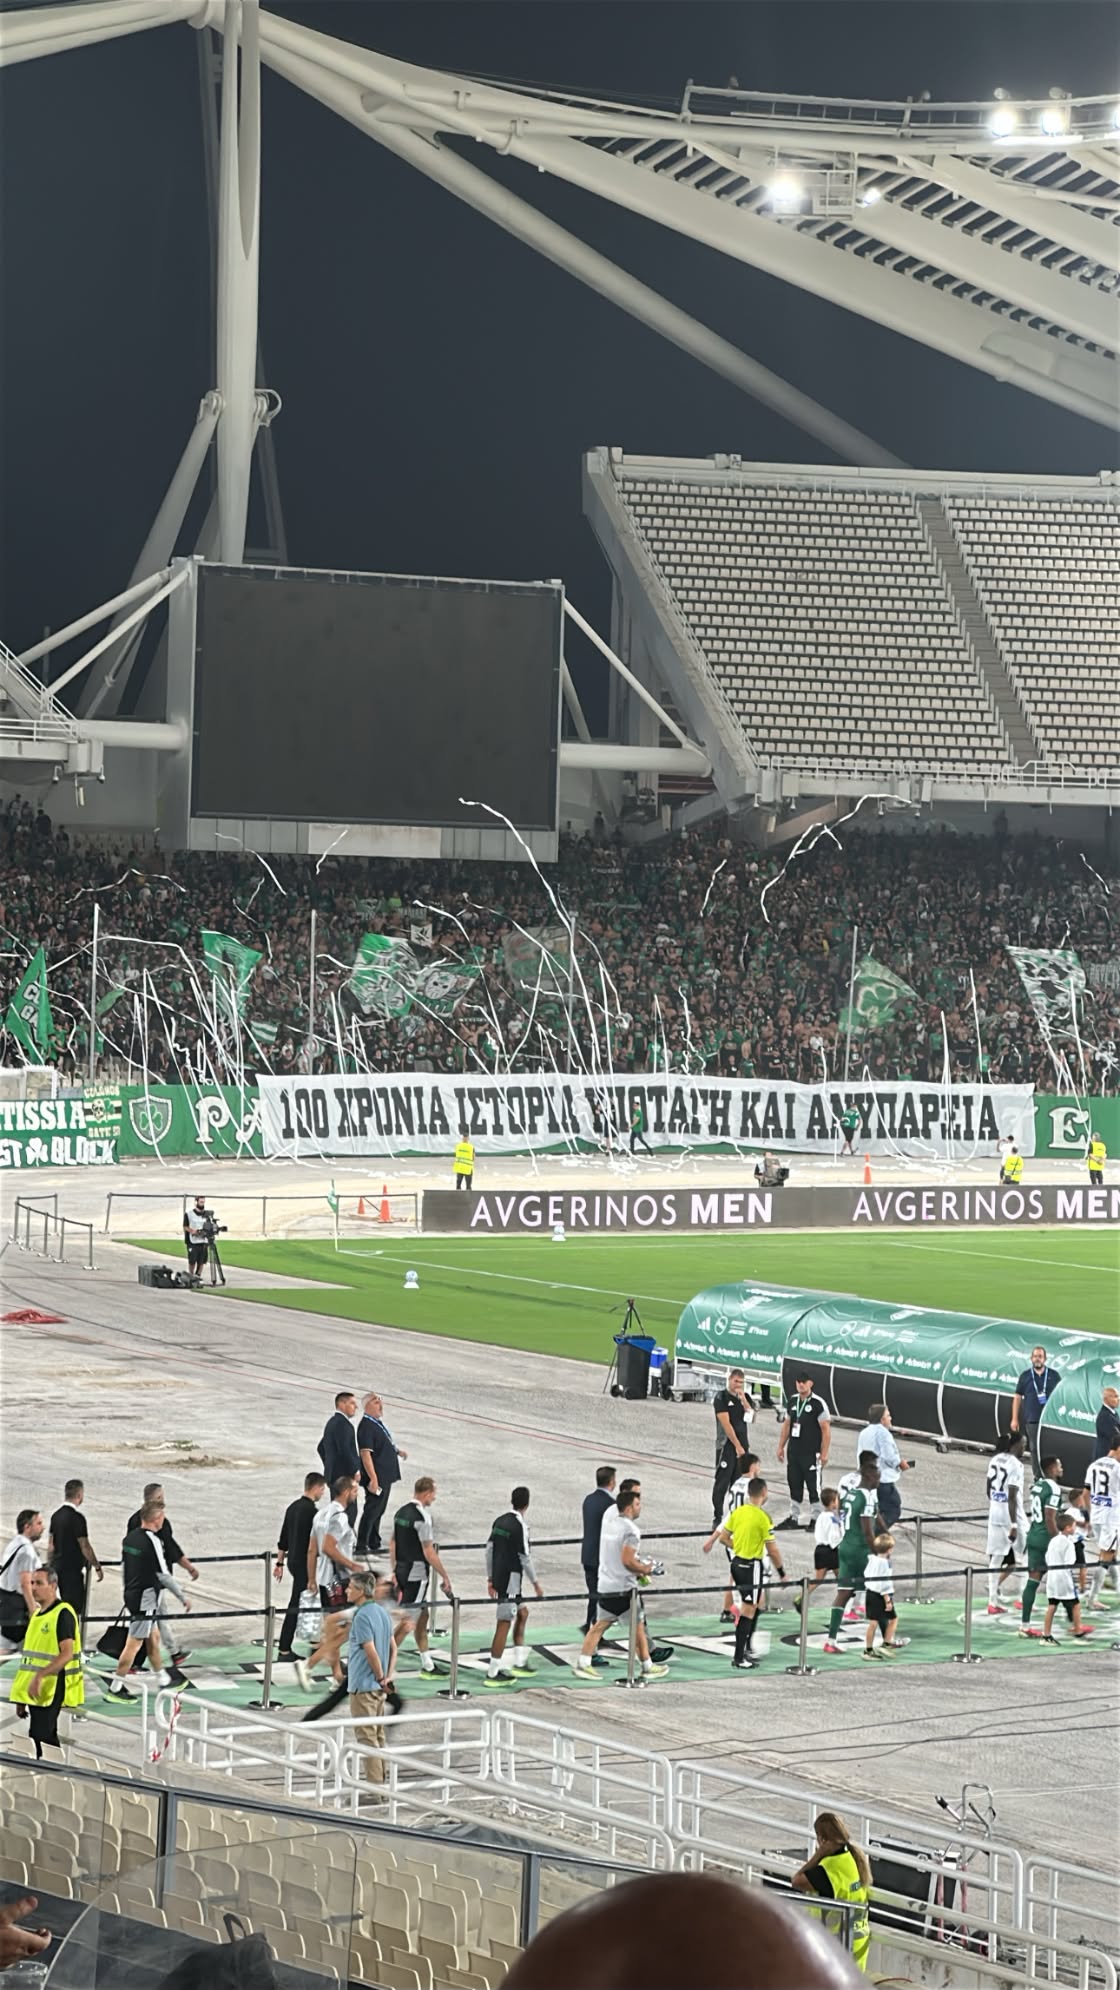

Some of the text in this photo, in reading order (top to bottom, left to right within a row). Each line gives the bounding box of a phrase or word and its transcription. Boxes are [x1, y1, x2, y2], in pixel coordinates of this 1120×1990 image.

[0, 1101, 86, 1131] TISSIA
[280, 1088, 329, 1138] 100
[334, 1086, 450, 1137] ΧΡΟΝΙΑ
[454, 1085, 580, 1135] ΙΣΤΟΡΙΑ
[740, 1091, 796, 1139] ΚΑΙ
[51, 1135, 117, 1165] BLOCK
[470, 1193, 773, 1227] AVGERINOS MEN
[852, 1189, 1043, 1222] AVGERINOS
[991, 1465, 1008, 1491] 27
[1093, 1469, 1110, 1496] 13
